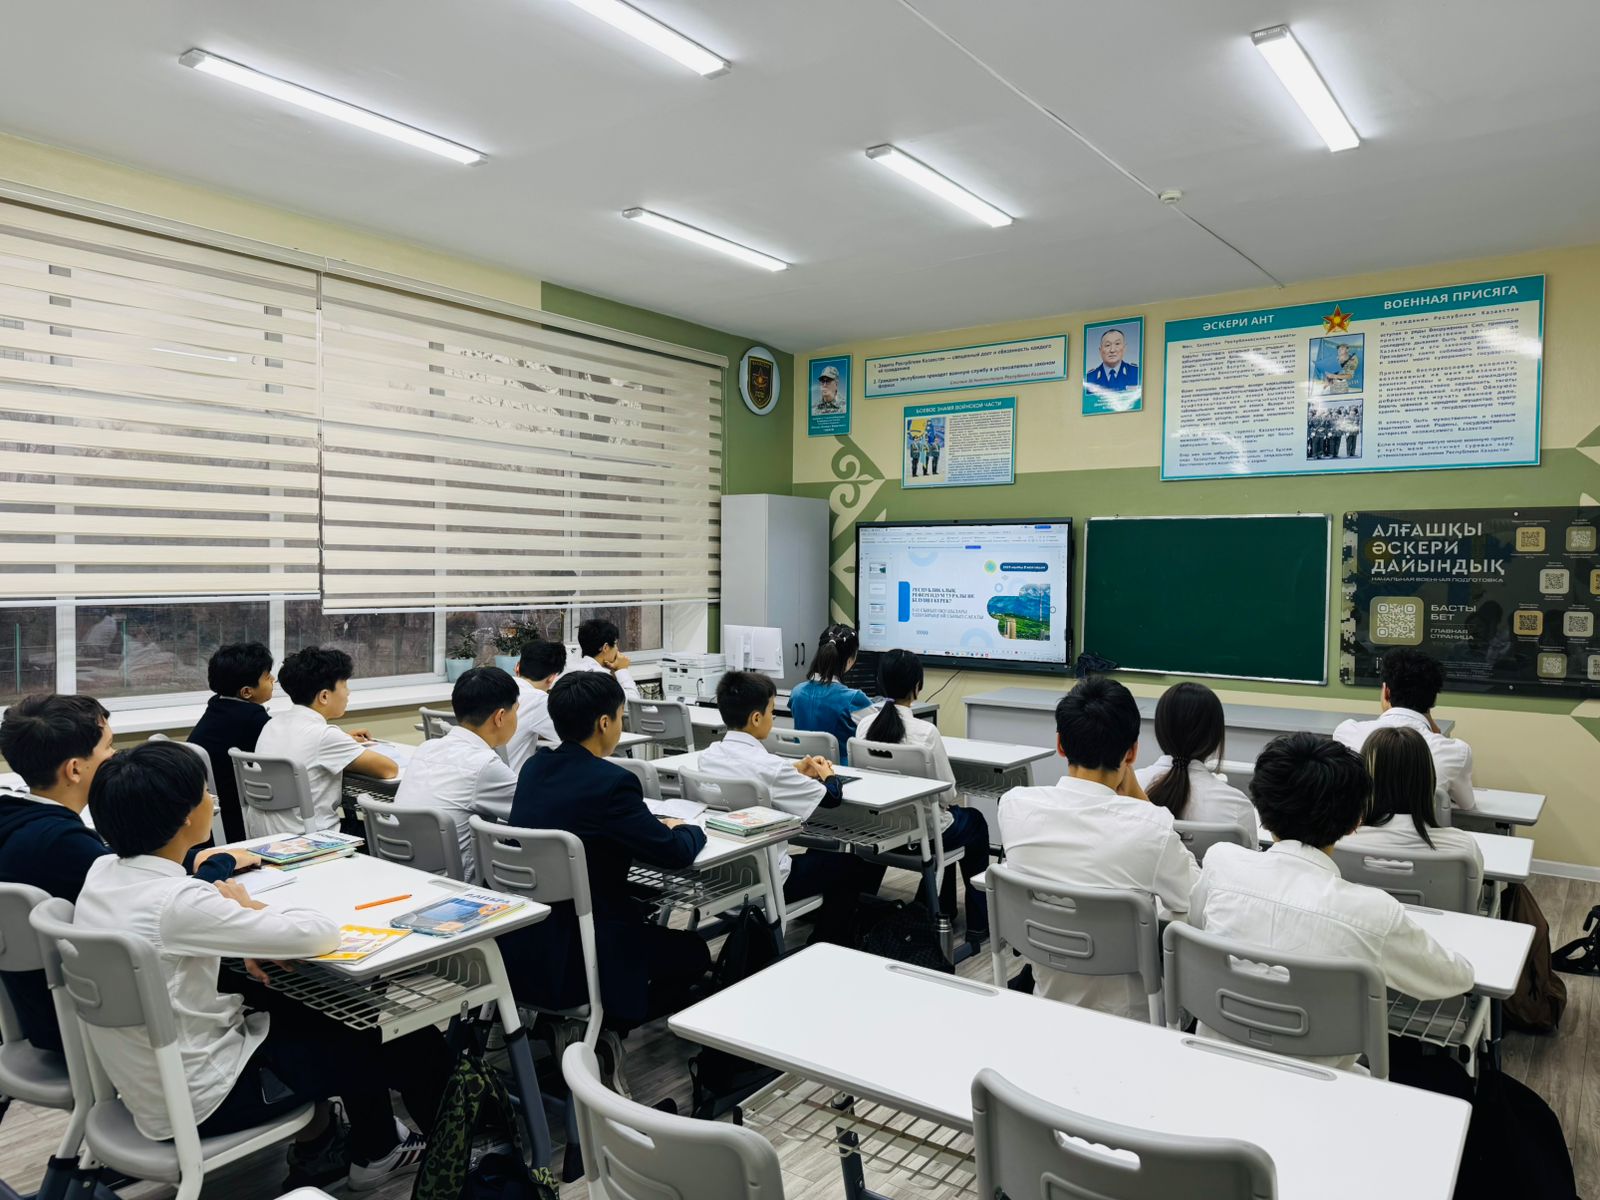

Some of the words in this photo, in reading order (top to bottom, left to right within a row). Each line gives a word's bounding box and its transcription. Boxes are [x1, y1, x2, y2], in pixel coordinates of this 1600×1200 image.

[1384, 293, 1448, 310] ВОЕННАЯ
[1452, 286, 1518, 302] ПРИСЯГА
[1202, 318, 1247, 331] ӘСКЕРИ
[1250, 314, 1274, 326] АНТ
[1372, 522, 1482, 539] АЛҒАШҚЫ
[1372, 541, 1458, 555] ӘСКЕРИ
[1371, 555, 1505, 576] ДАЙЫНДЫҚ
